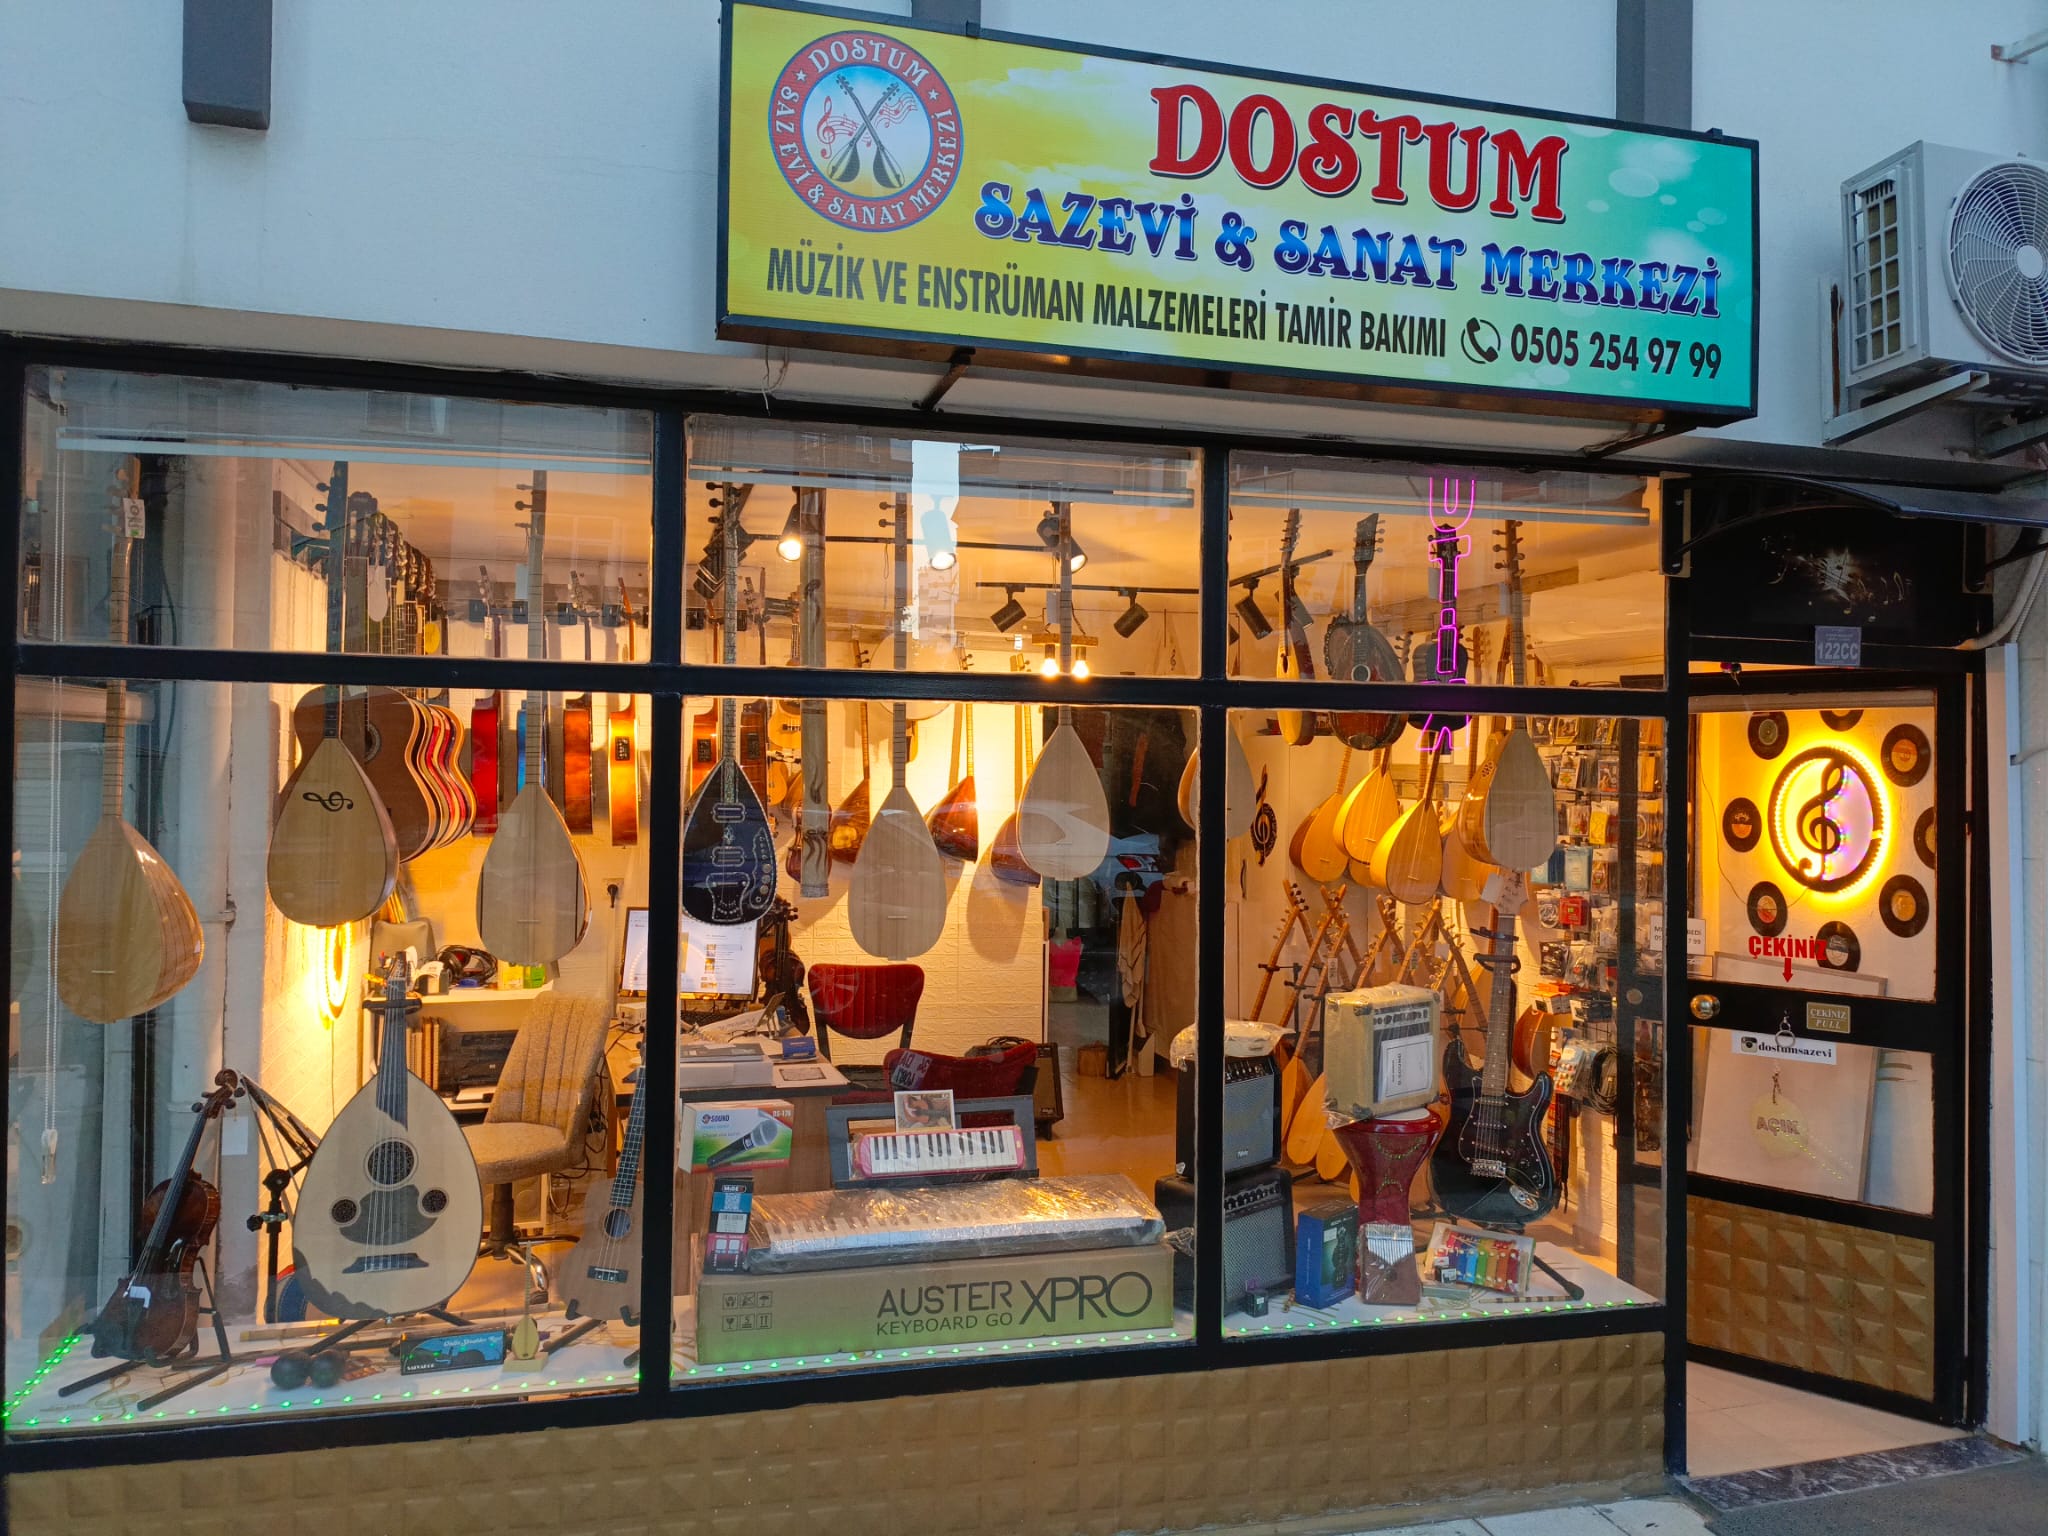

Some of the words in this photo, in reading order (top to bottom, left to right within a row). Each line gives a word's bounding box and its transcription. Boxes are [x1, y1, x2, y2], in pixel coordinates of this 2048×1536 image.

[808, 38, 929, 87] DOSTUM
[775, 86, 800, 134] SAZ
[779, 142, 815, 184] EVİ
[909, 108, 957, 212] MERKEZİ
[1149, 84, 1569, 223] DOSTUM
[808, 183, 825, 204] &
[827, 197, 907, 226] SANAT
[974, 181, 1199, 262] SAZEVİ
[1214, 211, 1257, 272] &
[1273, 219, 1467, 290] SANAT
[1480, 242, 1723, 319] MERKEZİ
[766, 239, 865, 301] MÜZİK
[872, 262, 907, 305] VE
[918, 262, 1084, 323] ENSTRÜMAN
[1093, 284, 1266, 341] MALZEMELERİ
[1276, 296, 1352, 349] TAMİR
[1360, 313, 1447, 357] BAKIMI
[1511, 323, 1580, 367] 0505
[1589, 335, 1639, 372] 254
[1647, 339, 1680, 375] 97
[1688, 342, 1722, 379] 99
[1748, 934, 1828, 961] ÇEKİNİZ
[1810, 1007, 1847, 1021] ÇEKİNİZ
[1815, 1018, 1842, 1030] PULL
[1758, 1042, 1832, 1058] dostumsazevi
[876, 1280, 1013, 1319] AUSTER
[1018, 1271, 1153, 1326] XPRO
[876, 1313, 978, 1336] KEYBOARD
[985, 1312, 1013, 1327] GO
